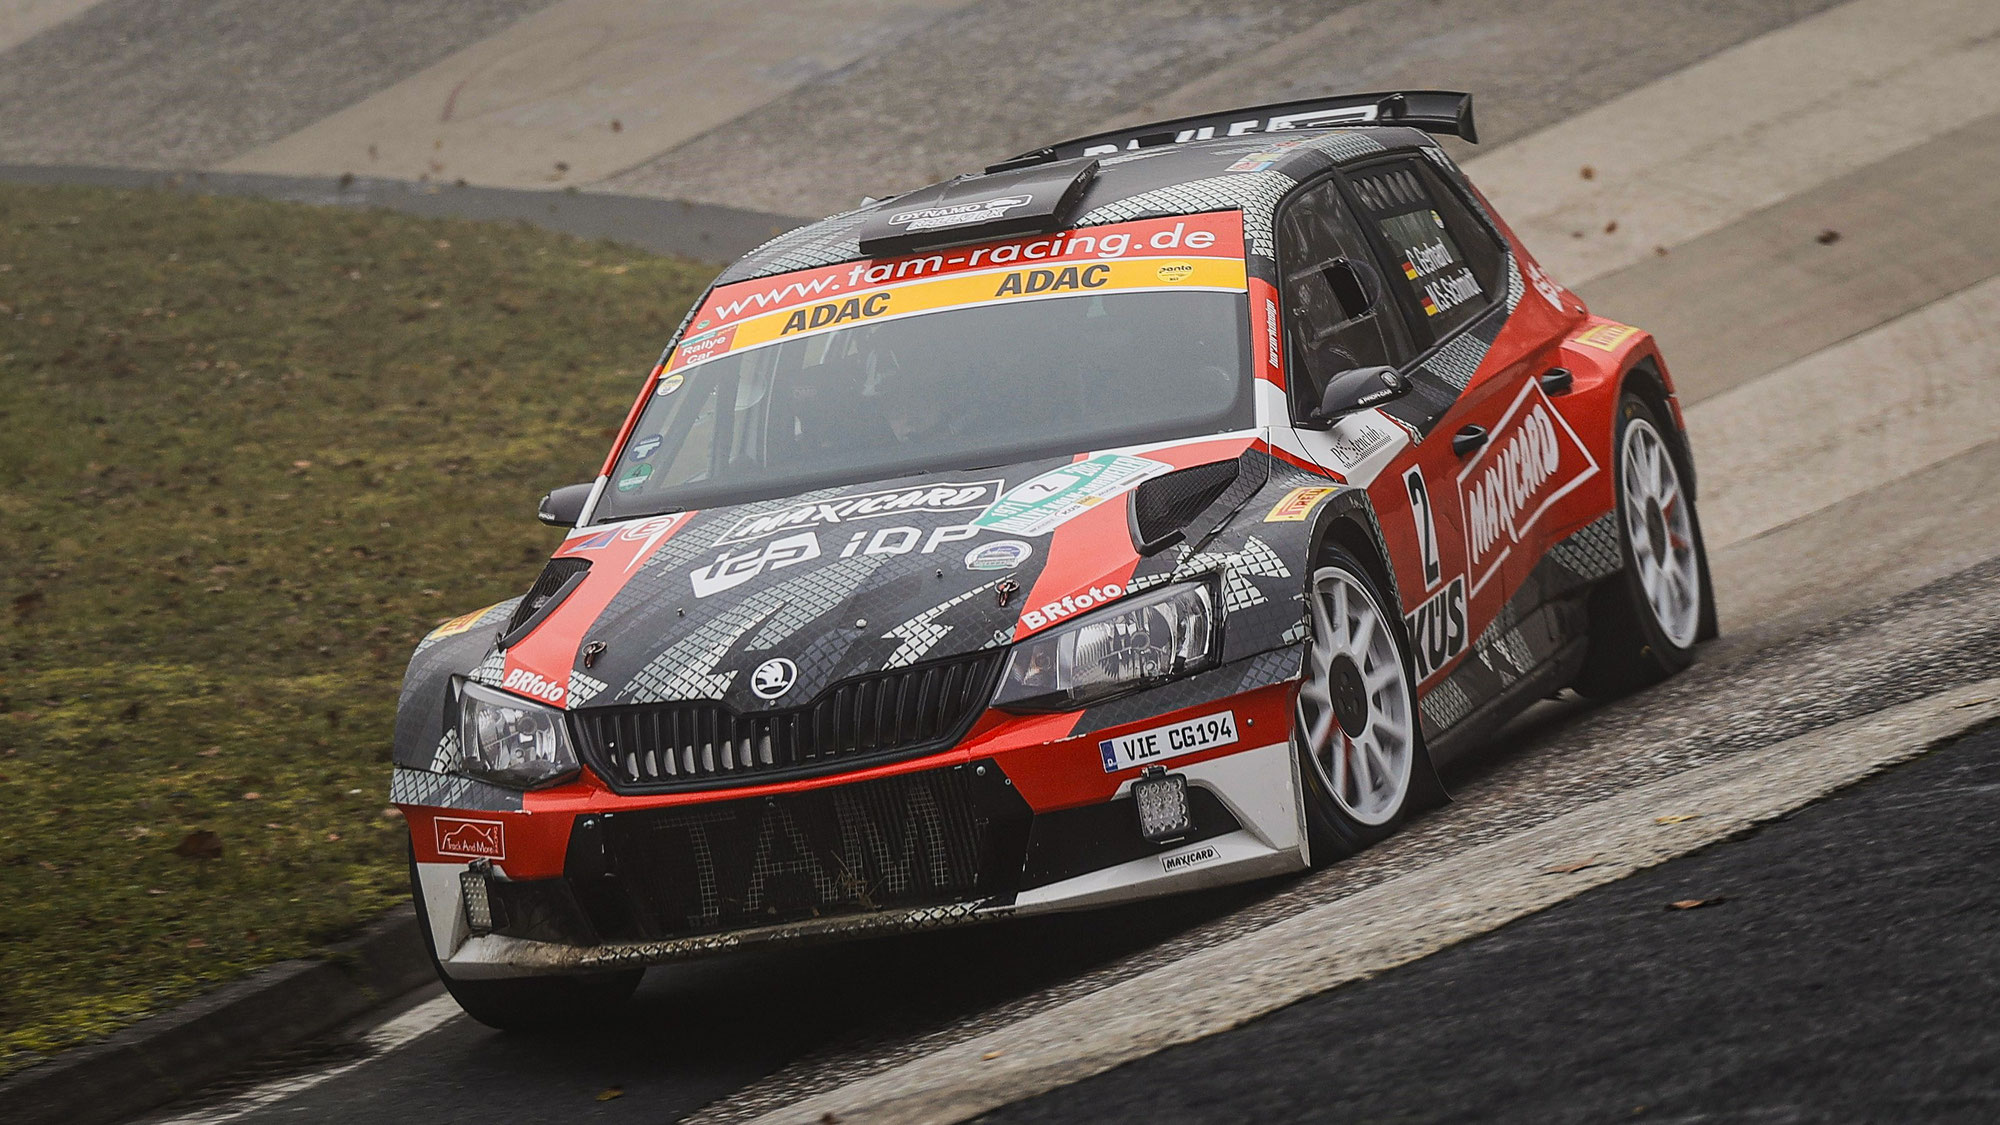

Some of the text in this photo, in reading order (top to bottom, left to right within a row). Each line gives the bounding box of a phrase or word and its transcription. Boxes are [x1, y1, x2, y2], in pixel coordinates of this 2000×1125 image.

[898, 205, 981, 221] DYNAMO
[716, 223, 1216, 320] www.tam-racing.de
[781, 264, 1111, 335] ADAC ADAC
[681, 336, 727, 357] Rallye
[686, 350, 715, 365] Car
[991, 501, 1033, 517] 1971
[1029, 483, 1059, 492] 2
[1469, 403, 1560, 565] MAXICARD
[735, 486, 987, 537] MAXICARD
[1408, 471, 1439, 586] 2
[1020, 583, 1123, 631] BRfoto
[1405, 577, 1467, 682] KÜS
[503, 668, 566, 702] BRfoto
[1123, 733, 1161, 762] VIE
[1168, 717, 1233, 751] CG194
[462, 839, 476, 852] And
[1166, 848, 1214, 869] MAXICARD
